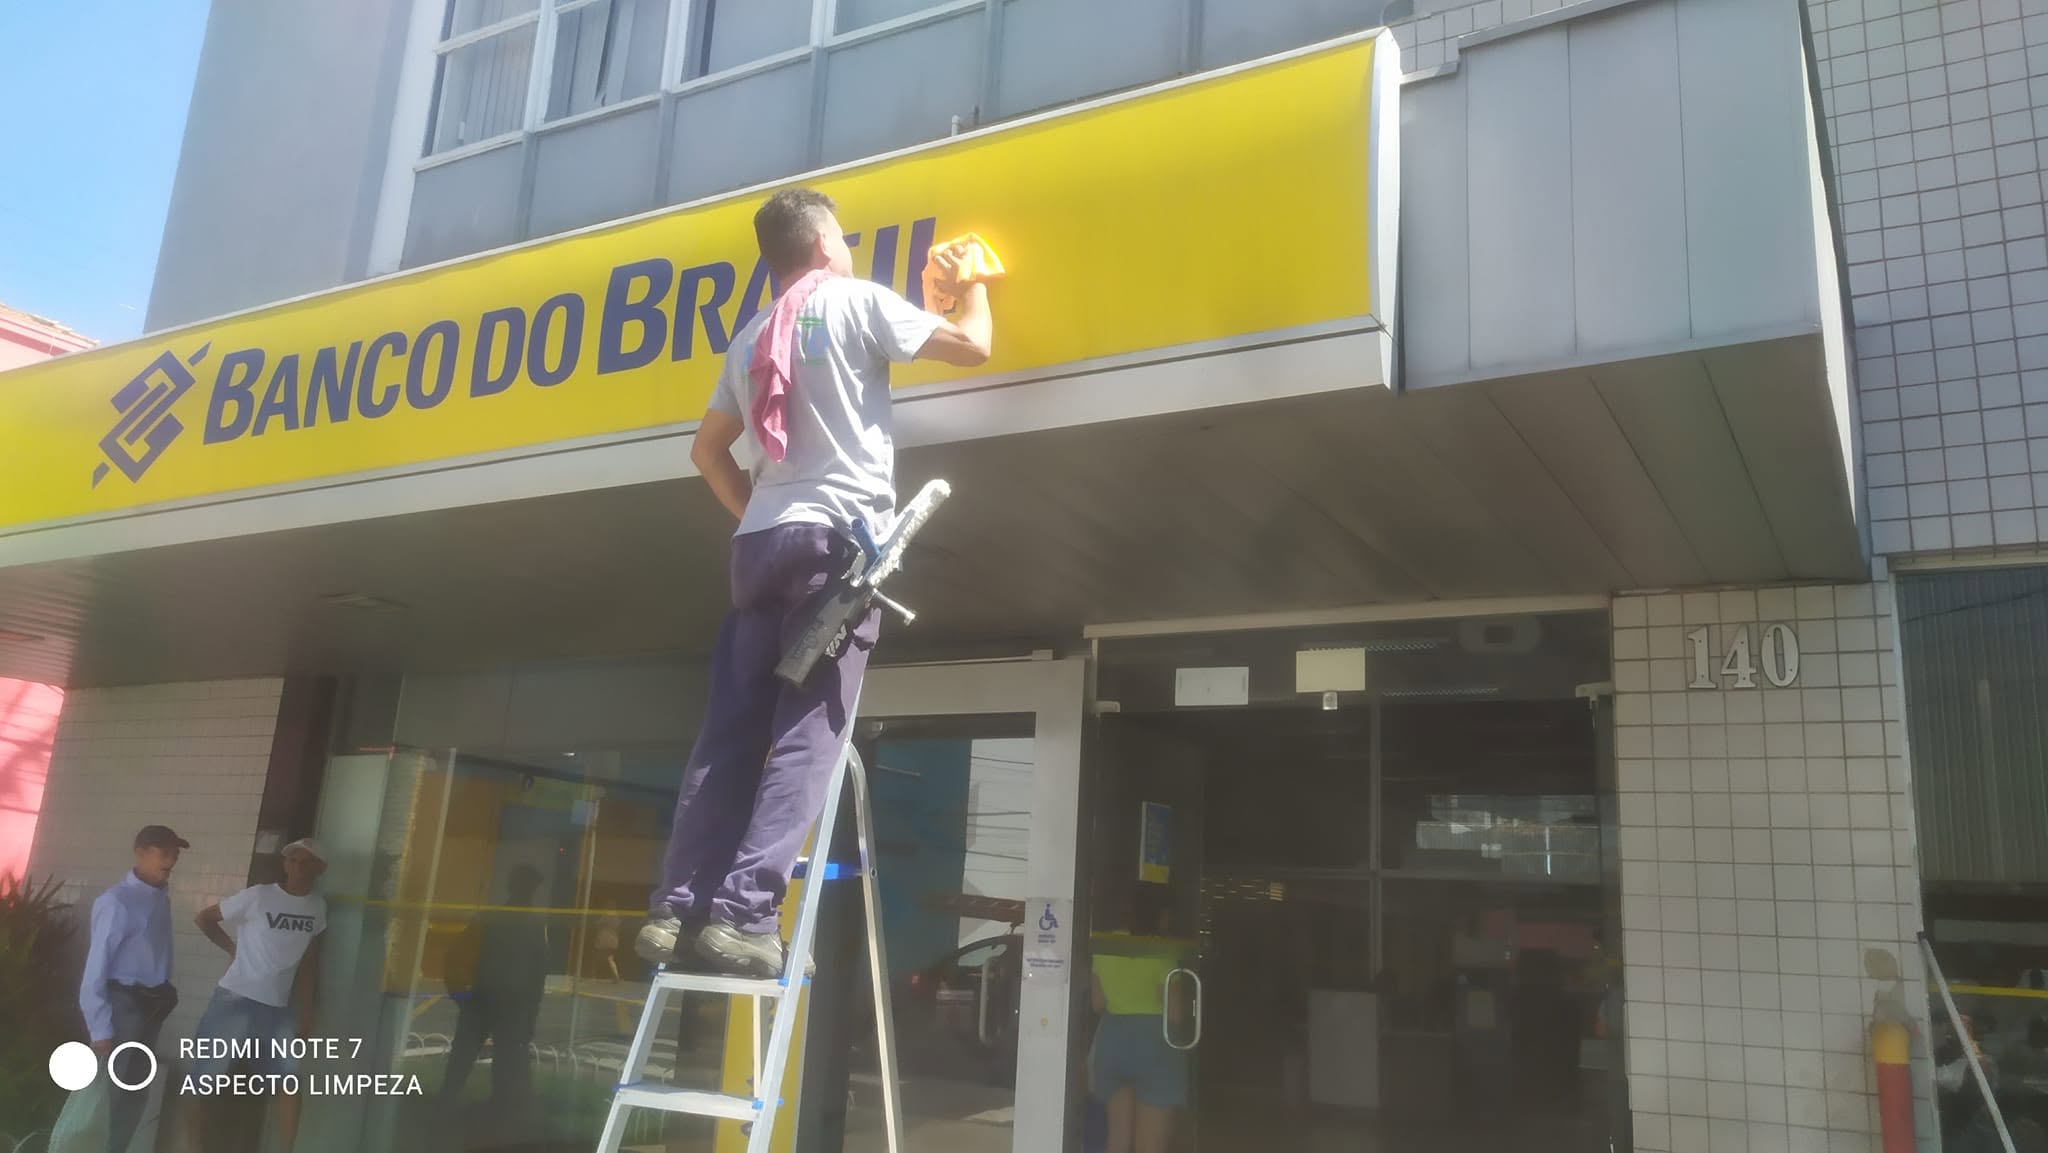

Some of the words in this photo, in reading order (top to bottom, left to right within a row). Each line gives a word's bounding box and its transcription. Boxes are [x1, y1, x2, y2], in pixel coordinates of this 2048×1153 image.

[203, 320, 460, 445] BANCO
[470, 292, 584, 398] DO
[597, 217, 957, 375] BRAIL
[1687, 623, 1800, 689] 140
[265, 911, 316, 933] VANS
